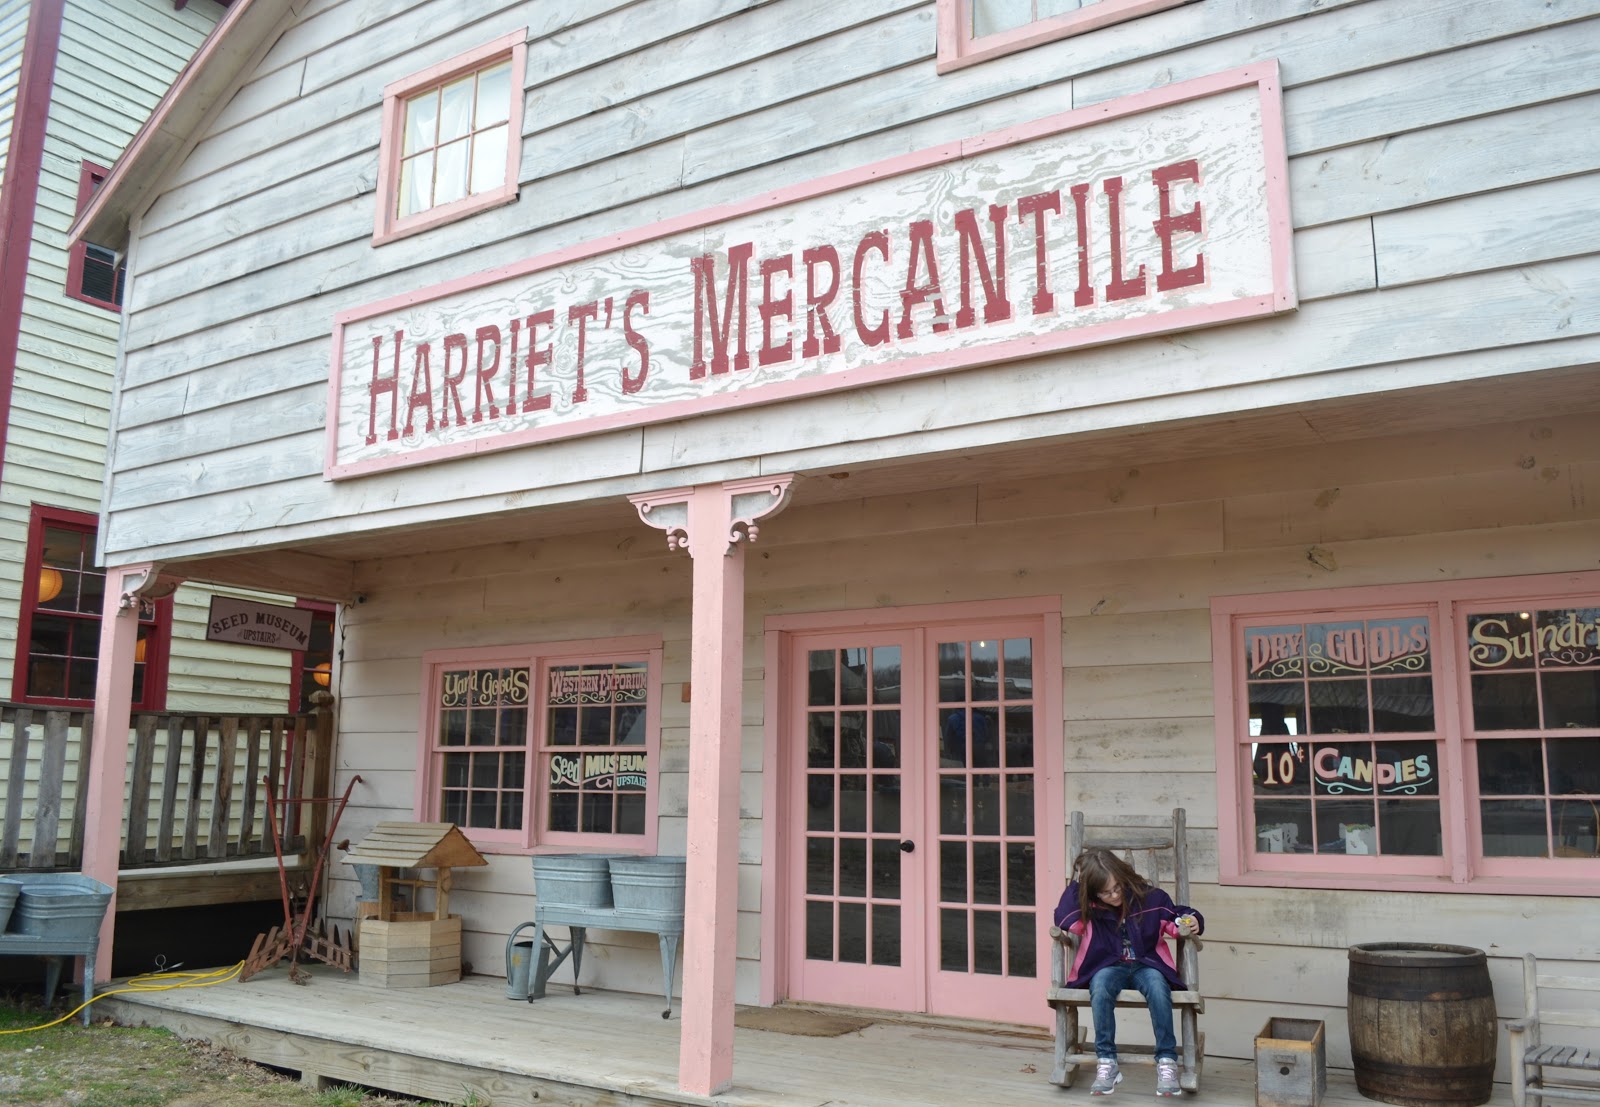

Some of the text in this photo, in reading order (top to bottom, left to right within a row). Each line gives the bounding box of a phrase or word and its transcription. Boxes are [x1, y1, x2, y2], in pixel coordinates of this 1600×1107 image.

[366, 158, 1207, 445] HARRIET'S MERCANTILE
[212, 612, 308, 645] SEED MUSEUM
[243, 629, 277, 643] UPSTAIRS
[1250, 632, 1303, 674] DRY
[442, 670, 479, 706] Yard
[550, 669, 647, 697] WESTERN EMPORIUM
[550, 754, 647, 785] Seed MUSEUM
[1314, 747, 1431, 786] CANDIES
